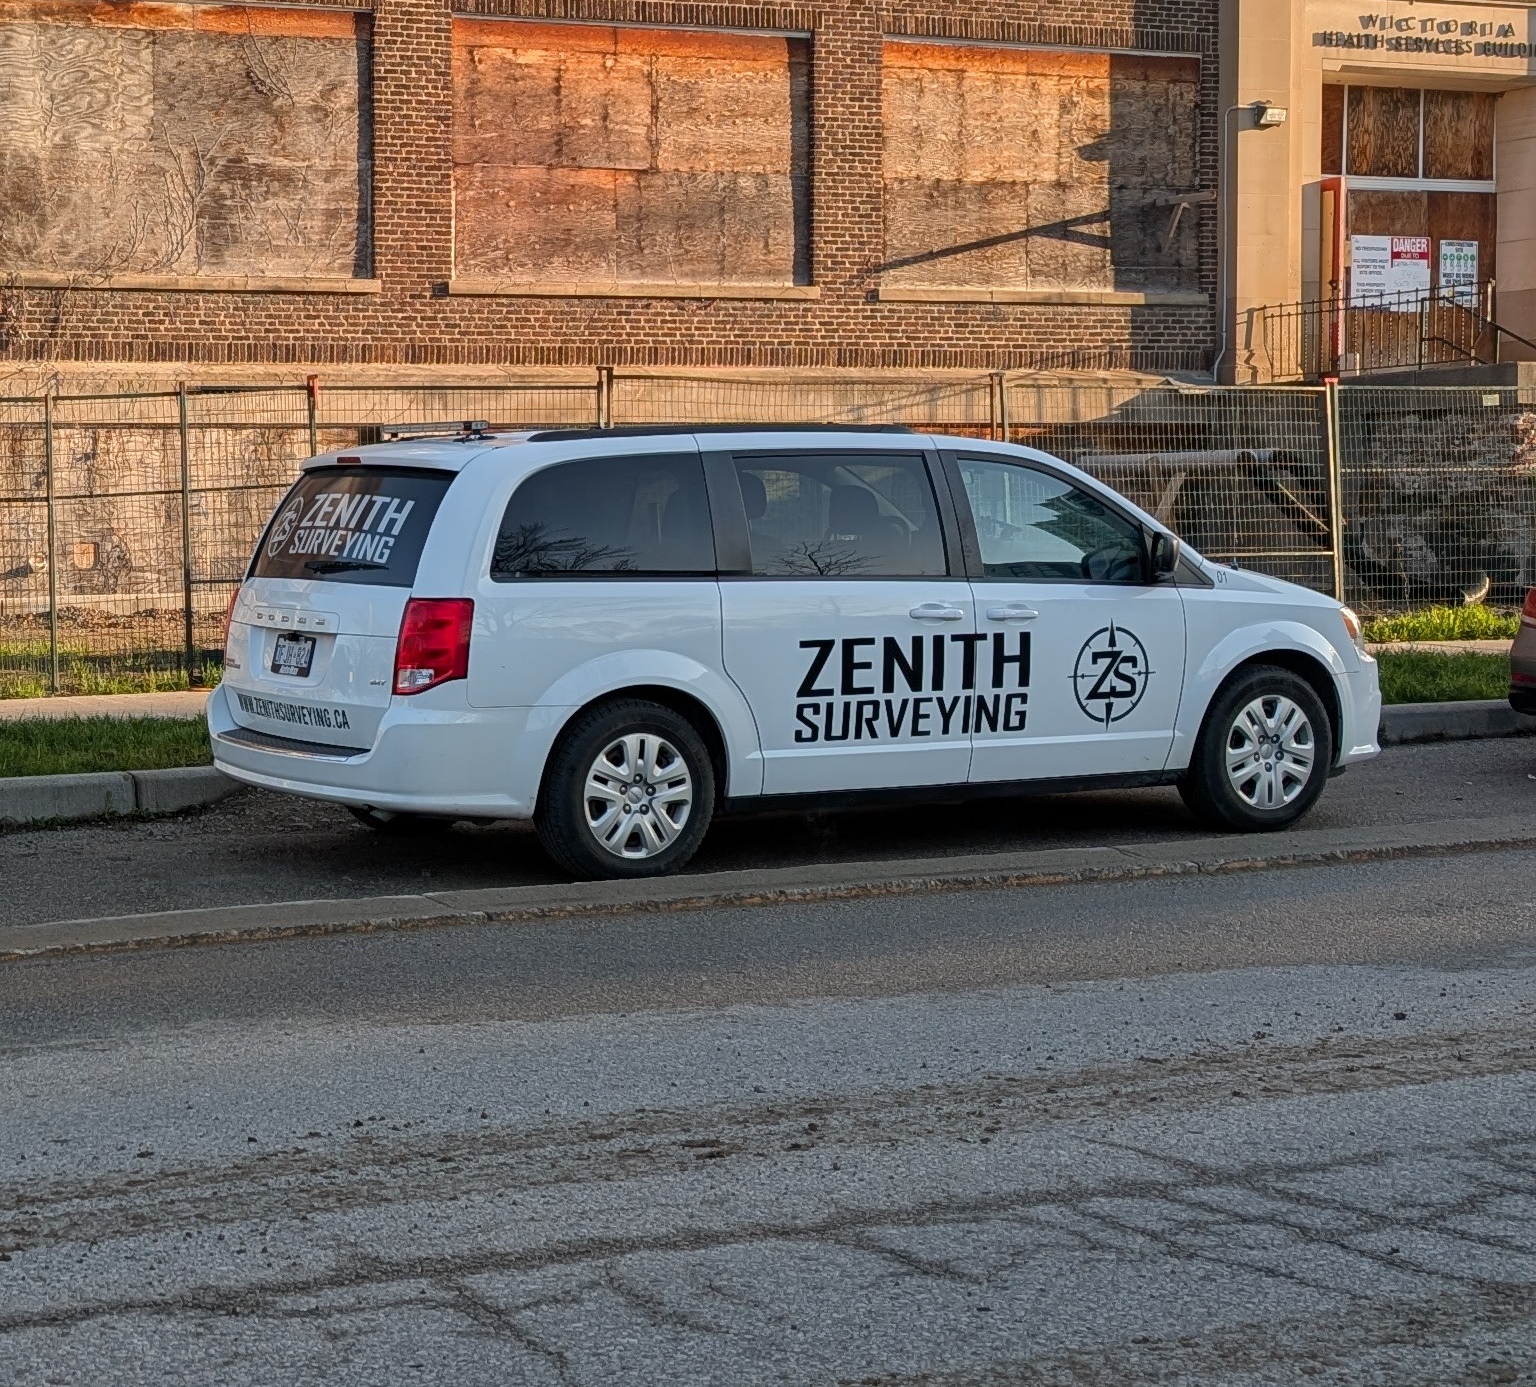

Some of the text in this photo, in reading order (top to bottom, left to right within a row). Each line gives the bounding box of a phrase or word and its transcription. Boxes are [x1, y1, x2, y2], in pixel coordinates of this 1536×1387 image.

[1366, 14, 1516, 37] VICTORIA
[1321, 31, 1536, 57] HEALTH SERVICES BUILDI
[1393, 237, 1428, 253] DANGER
[299, 493, 416, 536] ZENITH
[289, 528, 395, 564] SURVEYING
[1217, 570, 1228, 584] 01
[795, 631, 1032, 698] ZENITH
[1084, 649, 1138, 701] ZS
[236, 693, 353, 730] WWW.ZENITHSURVEYING.CA
[794, 692, 1029, 743] SURVEYING
